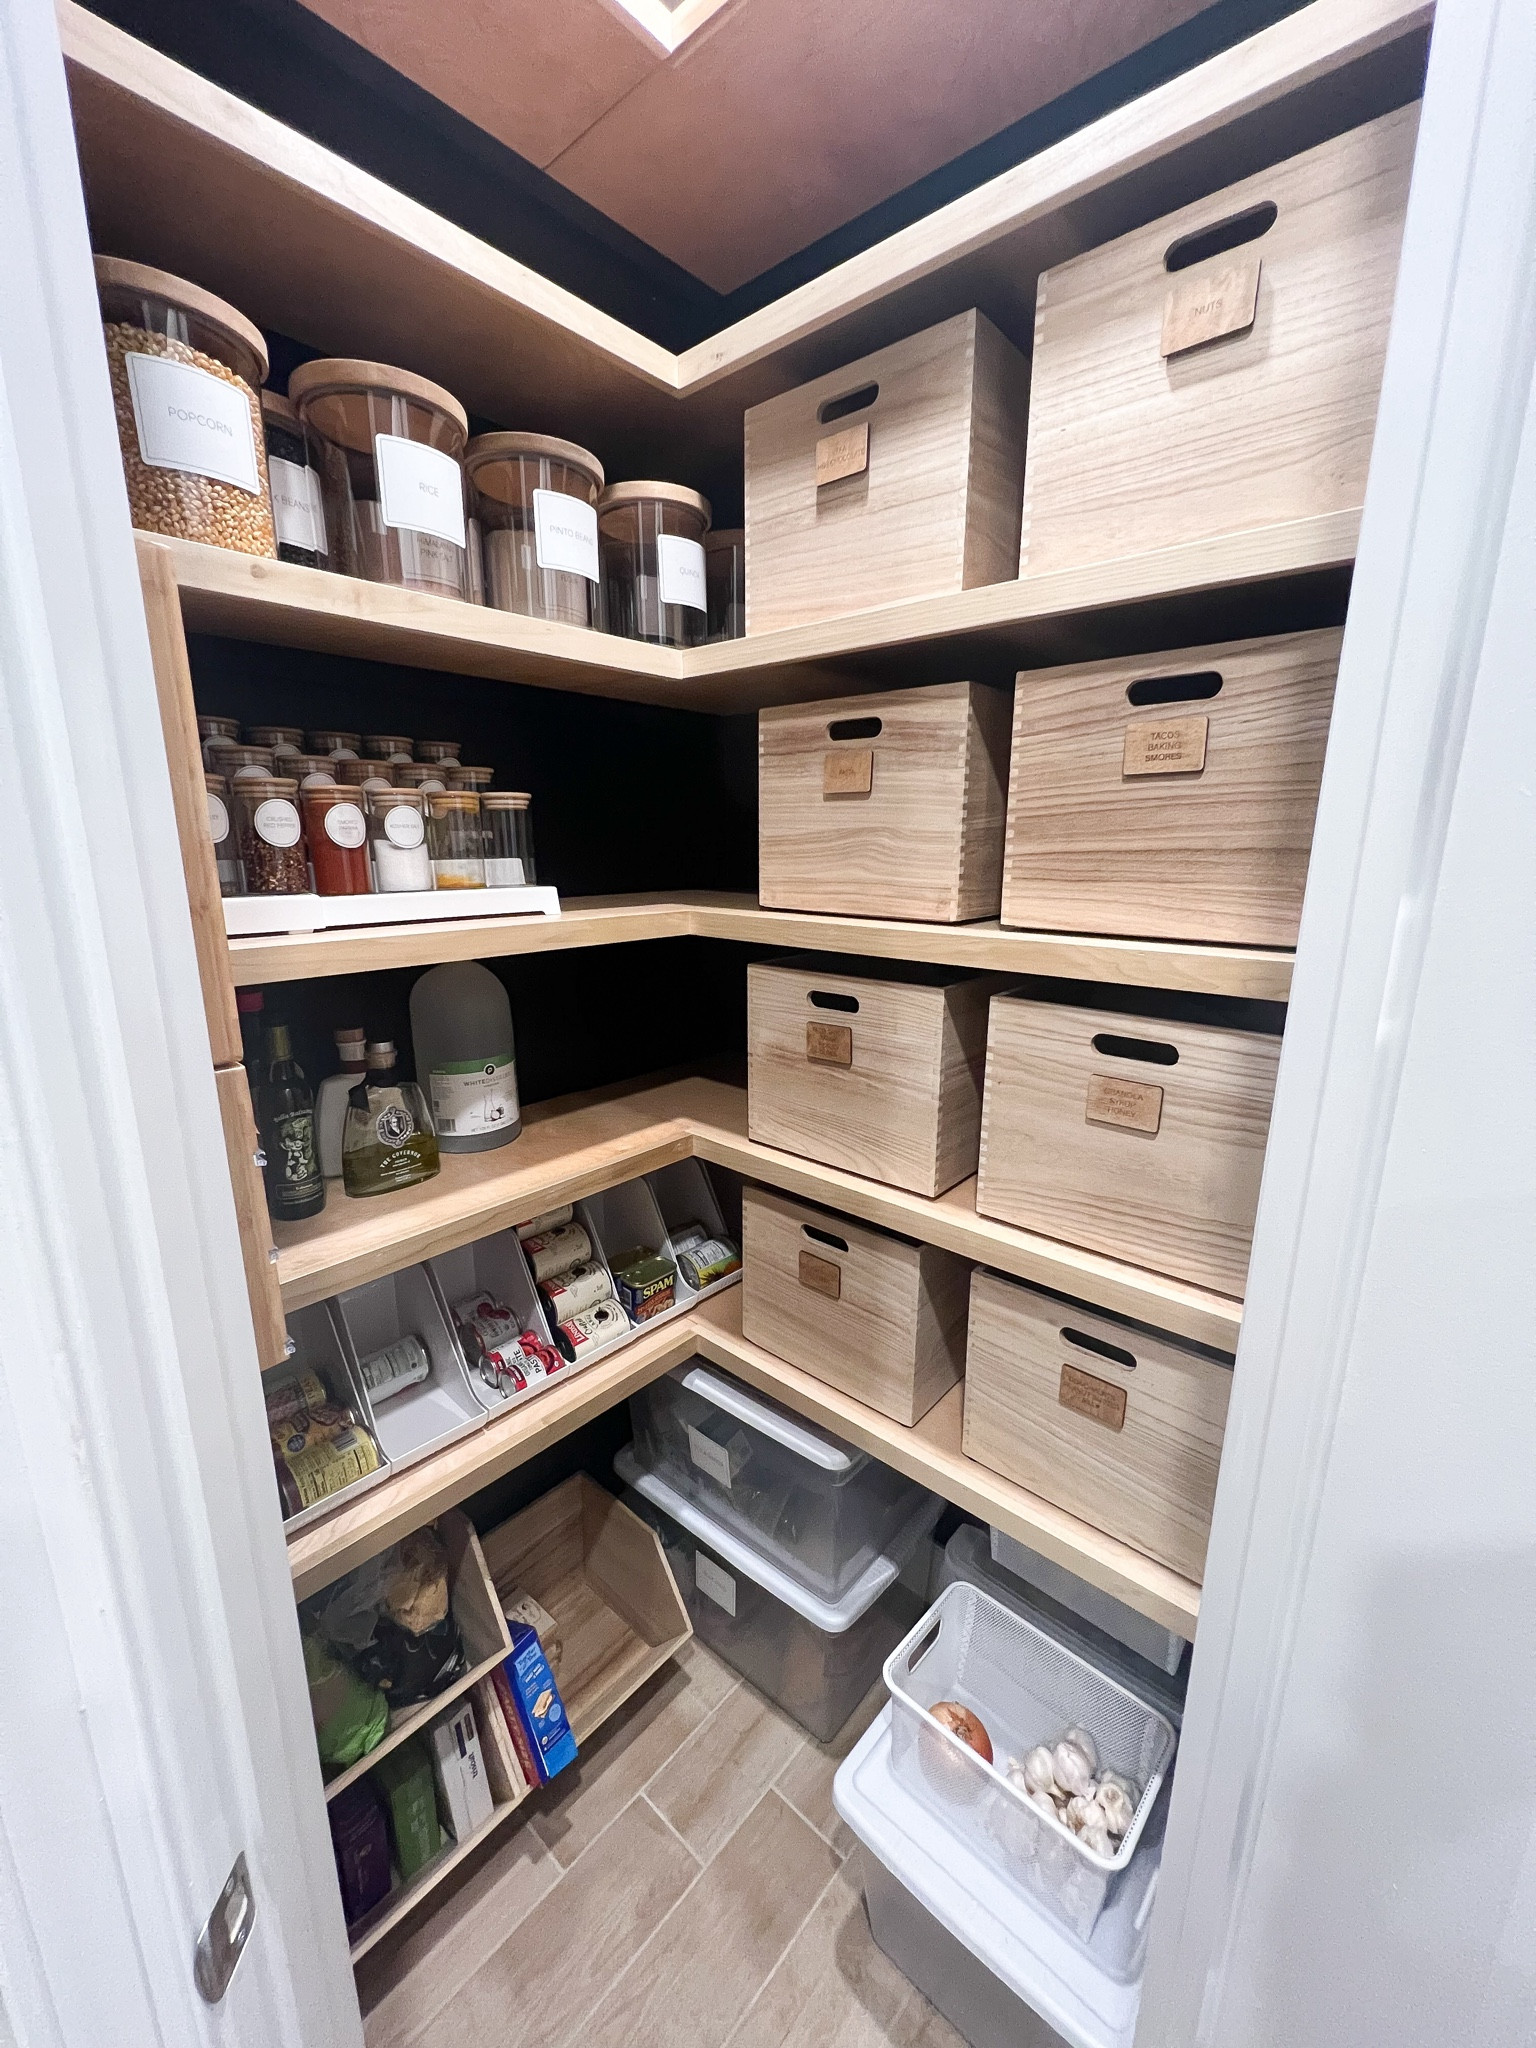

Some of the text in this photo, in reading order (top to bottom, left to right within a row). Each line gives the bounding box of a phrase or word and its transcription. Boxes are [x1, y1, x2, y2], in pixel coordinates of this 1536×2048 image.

[1194, 299, 1223, 316] NUTS
[167, 405, 233, 437] POPCORN
[419, 482, 440, 498] RICE
[281, 495, 311, 514] BEANS
[550, 524, 594, 546] PINTO BEANS
[679, 566, 700, 578] QUINOA
[1150, 731, 1180, 740] TACOS
[1147, 742, 1182, 751] BAKING
[1145, 753, 1182, 762] SMORES
[1103, 1087, 1144, 1101] GRANOLA
[1105, 1106, 1136, 1118] HONEY
[643, 1274, 674, 1299] SPAM
